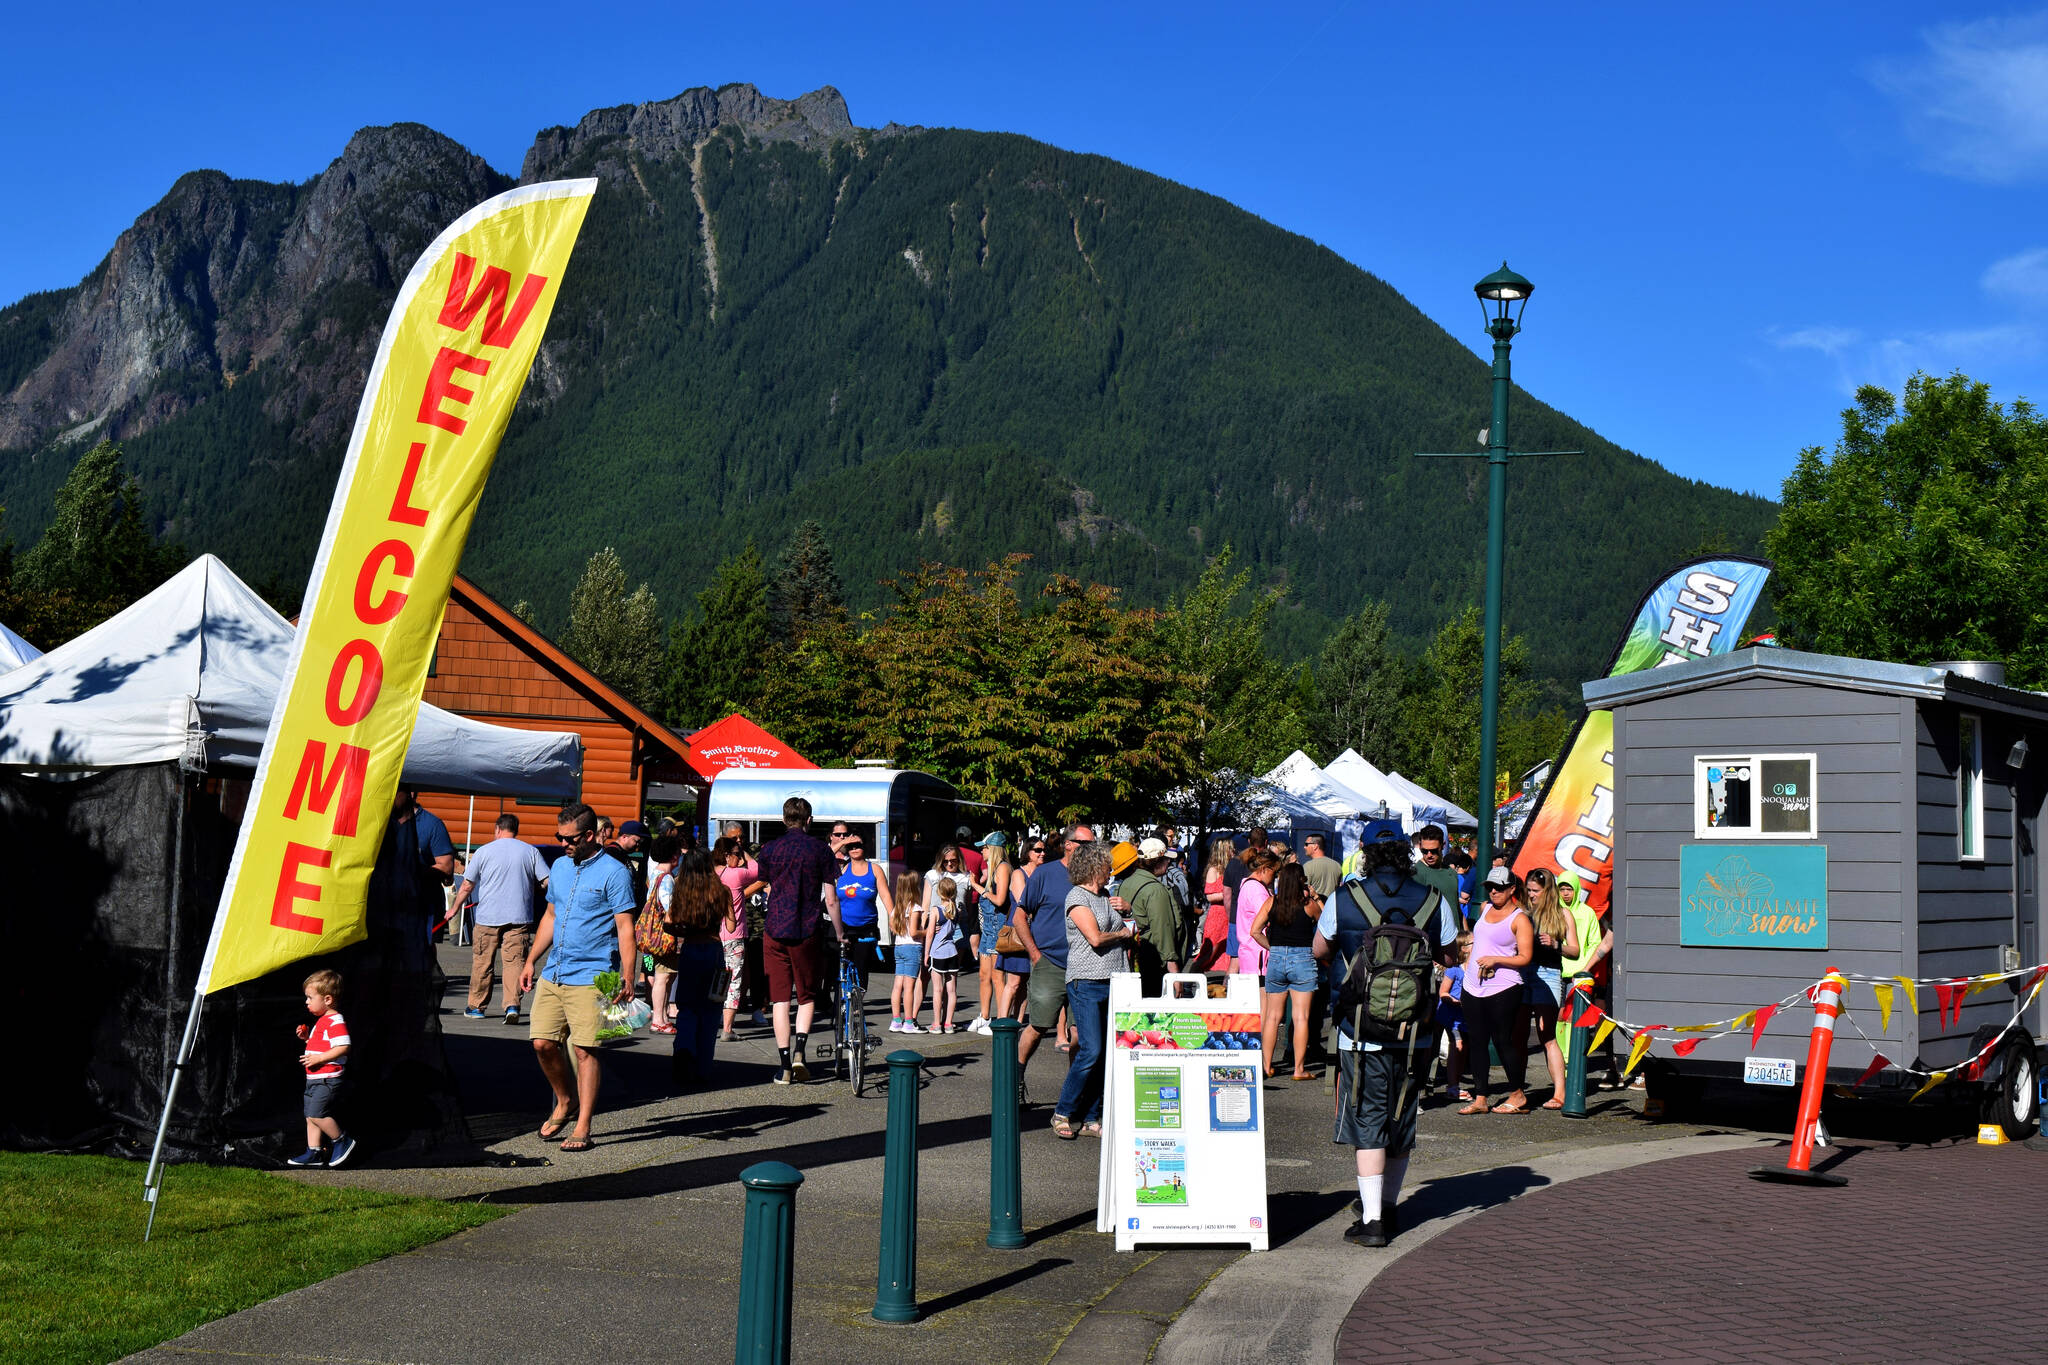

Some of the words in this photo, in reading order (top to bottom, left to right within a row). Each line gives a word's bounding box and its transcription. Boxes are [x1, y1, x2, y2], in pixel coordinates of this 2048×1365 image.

[270, 252, 547, 935] WELCOME
[700, 746, 732, 759] Smith
[733, 745, 780, 758] Brothers
[1761, 796, 1810, 804] SNOQUALMIE
[1782, 803, 1810, 811] snow
[1687, 895, 1820, 914] SNOQUALMIE
[1748, 912, 1819, 936] snow
[1748, 1066, 1792, 1082] 73045AE
